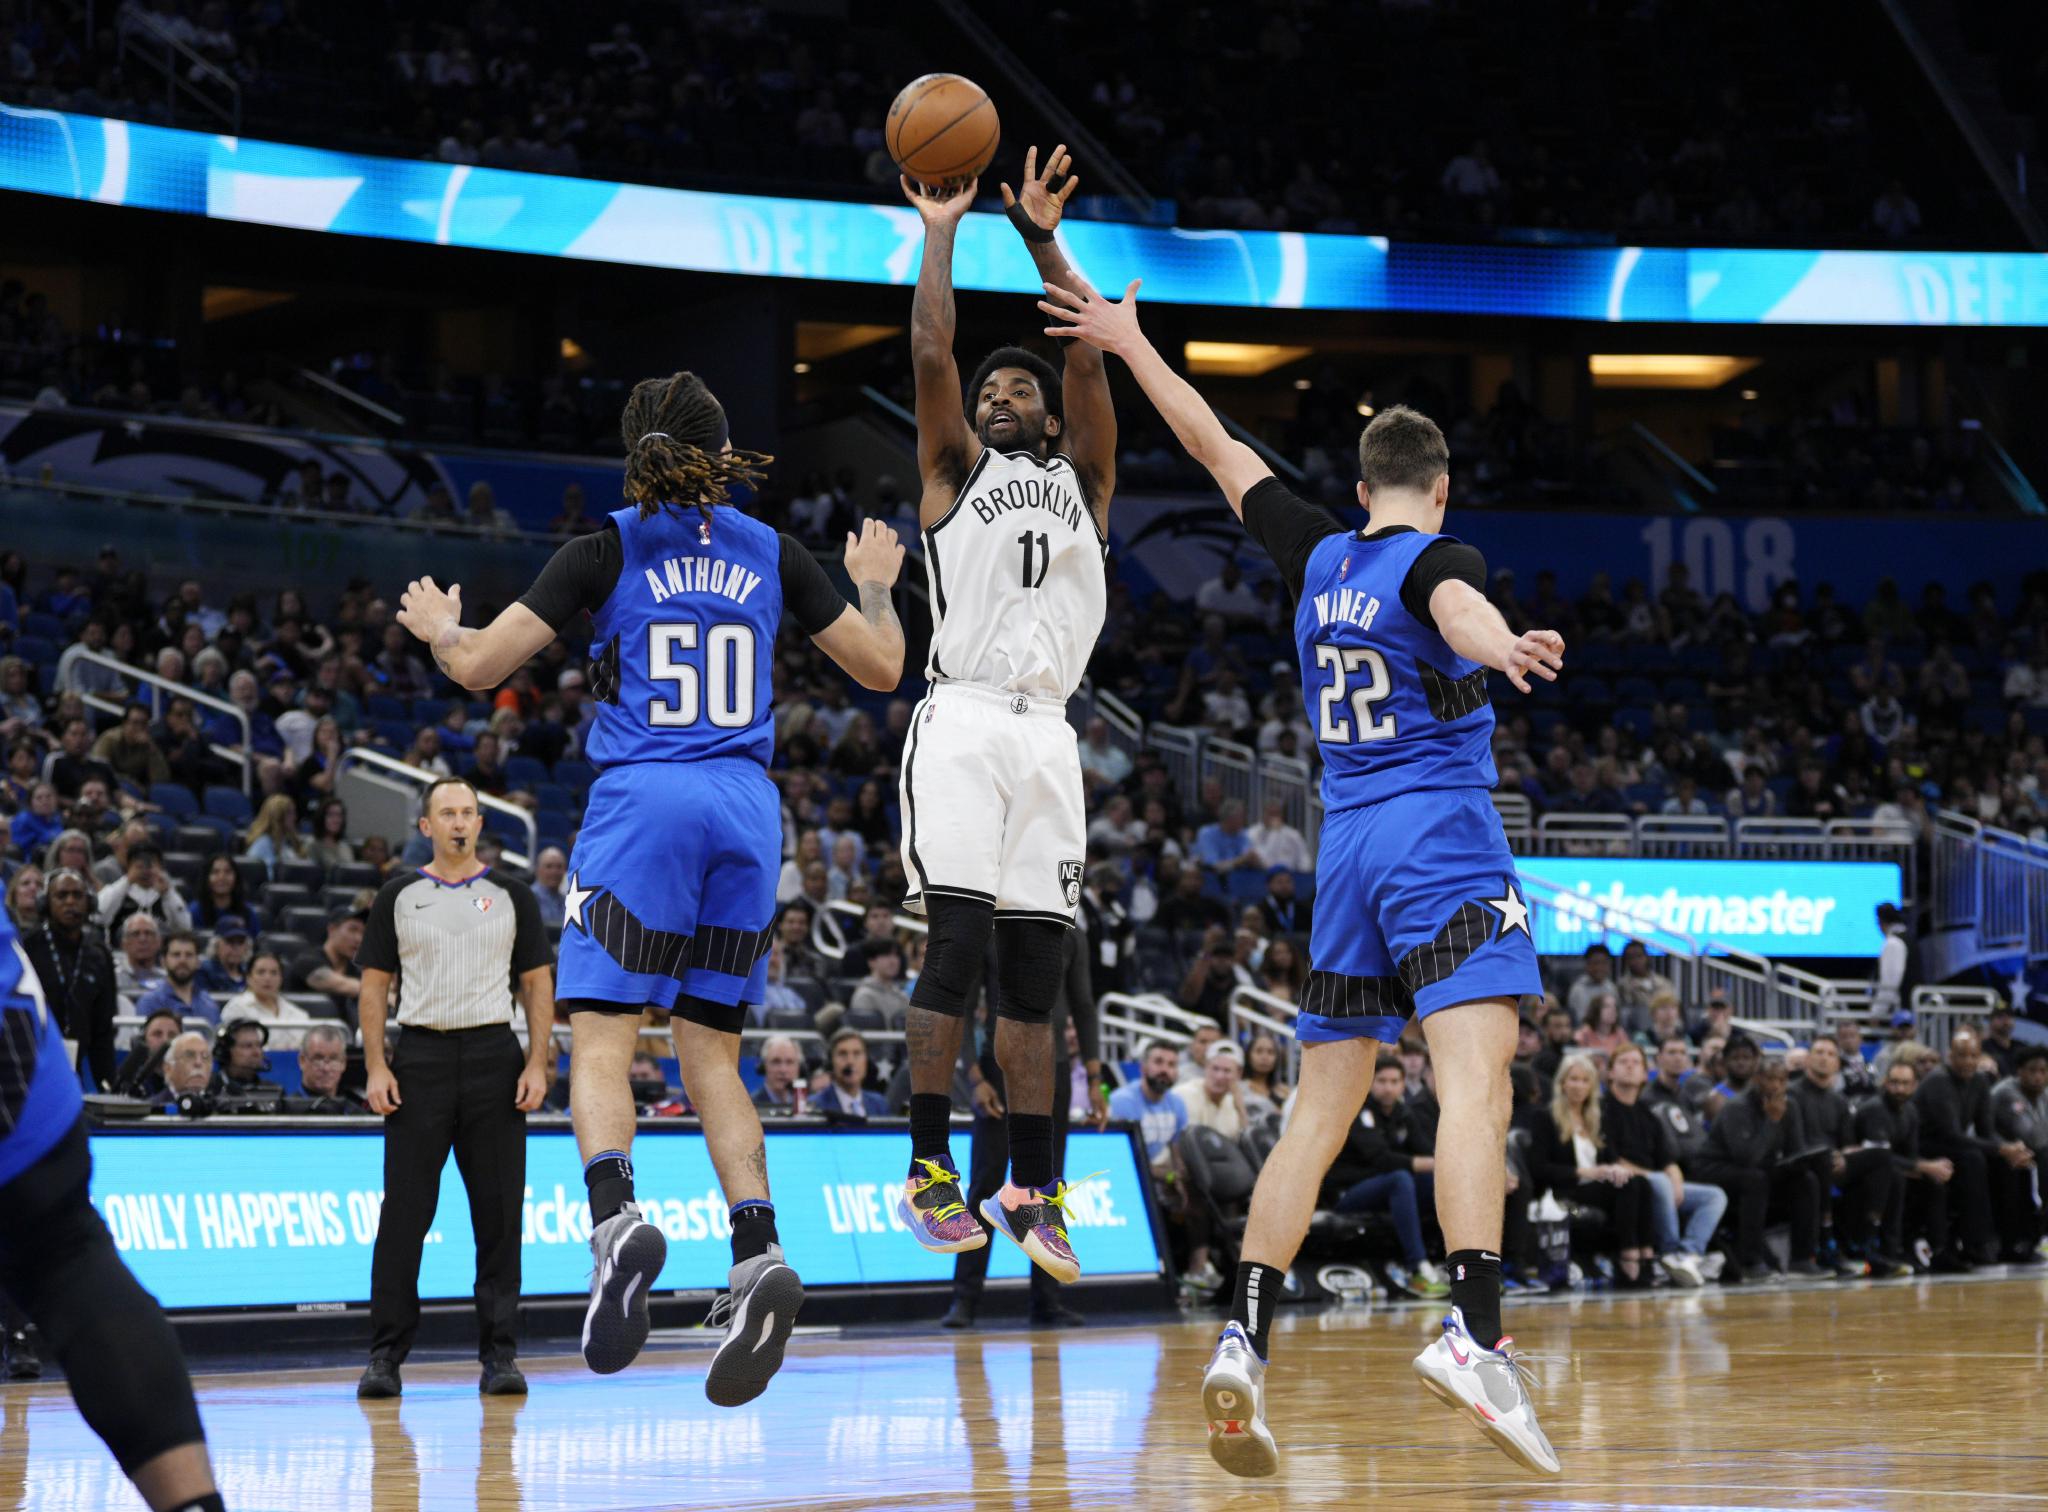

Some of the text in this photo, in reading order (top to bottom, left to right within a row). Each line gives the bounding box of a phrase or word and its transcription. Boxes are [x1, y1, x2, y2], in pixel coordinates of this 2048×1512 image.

[970, 479, 1082, 532] BROOKLYN
[645, 556, 761, 604] ANTHONY
[1017, 530, 1050, 588] 11
[1641, 517, 1796, 613] 108
[648, 622, 755, 728] 50
[1315, 643, 1397, 744] 22
[104, 1194, 188, 1251] ONLY
[194, 1191, 346, 1249] HAPPENS
[822, 1184, 886, 1234] LIVE
